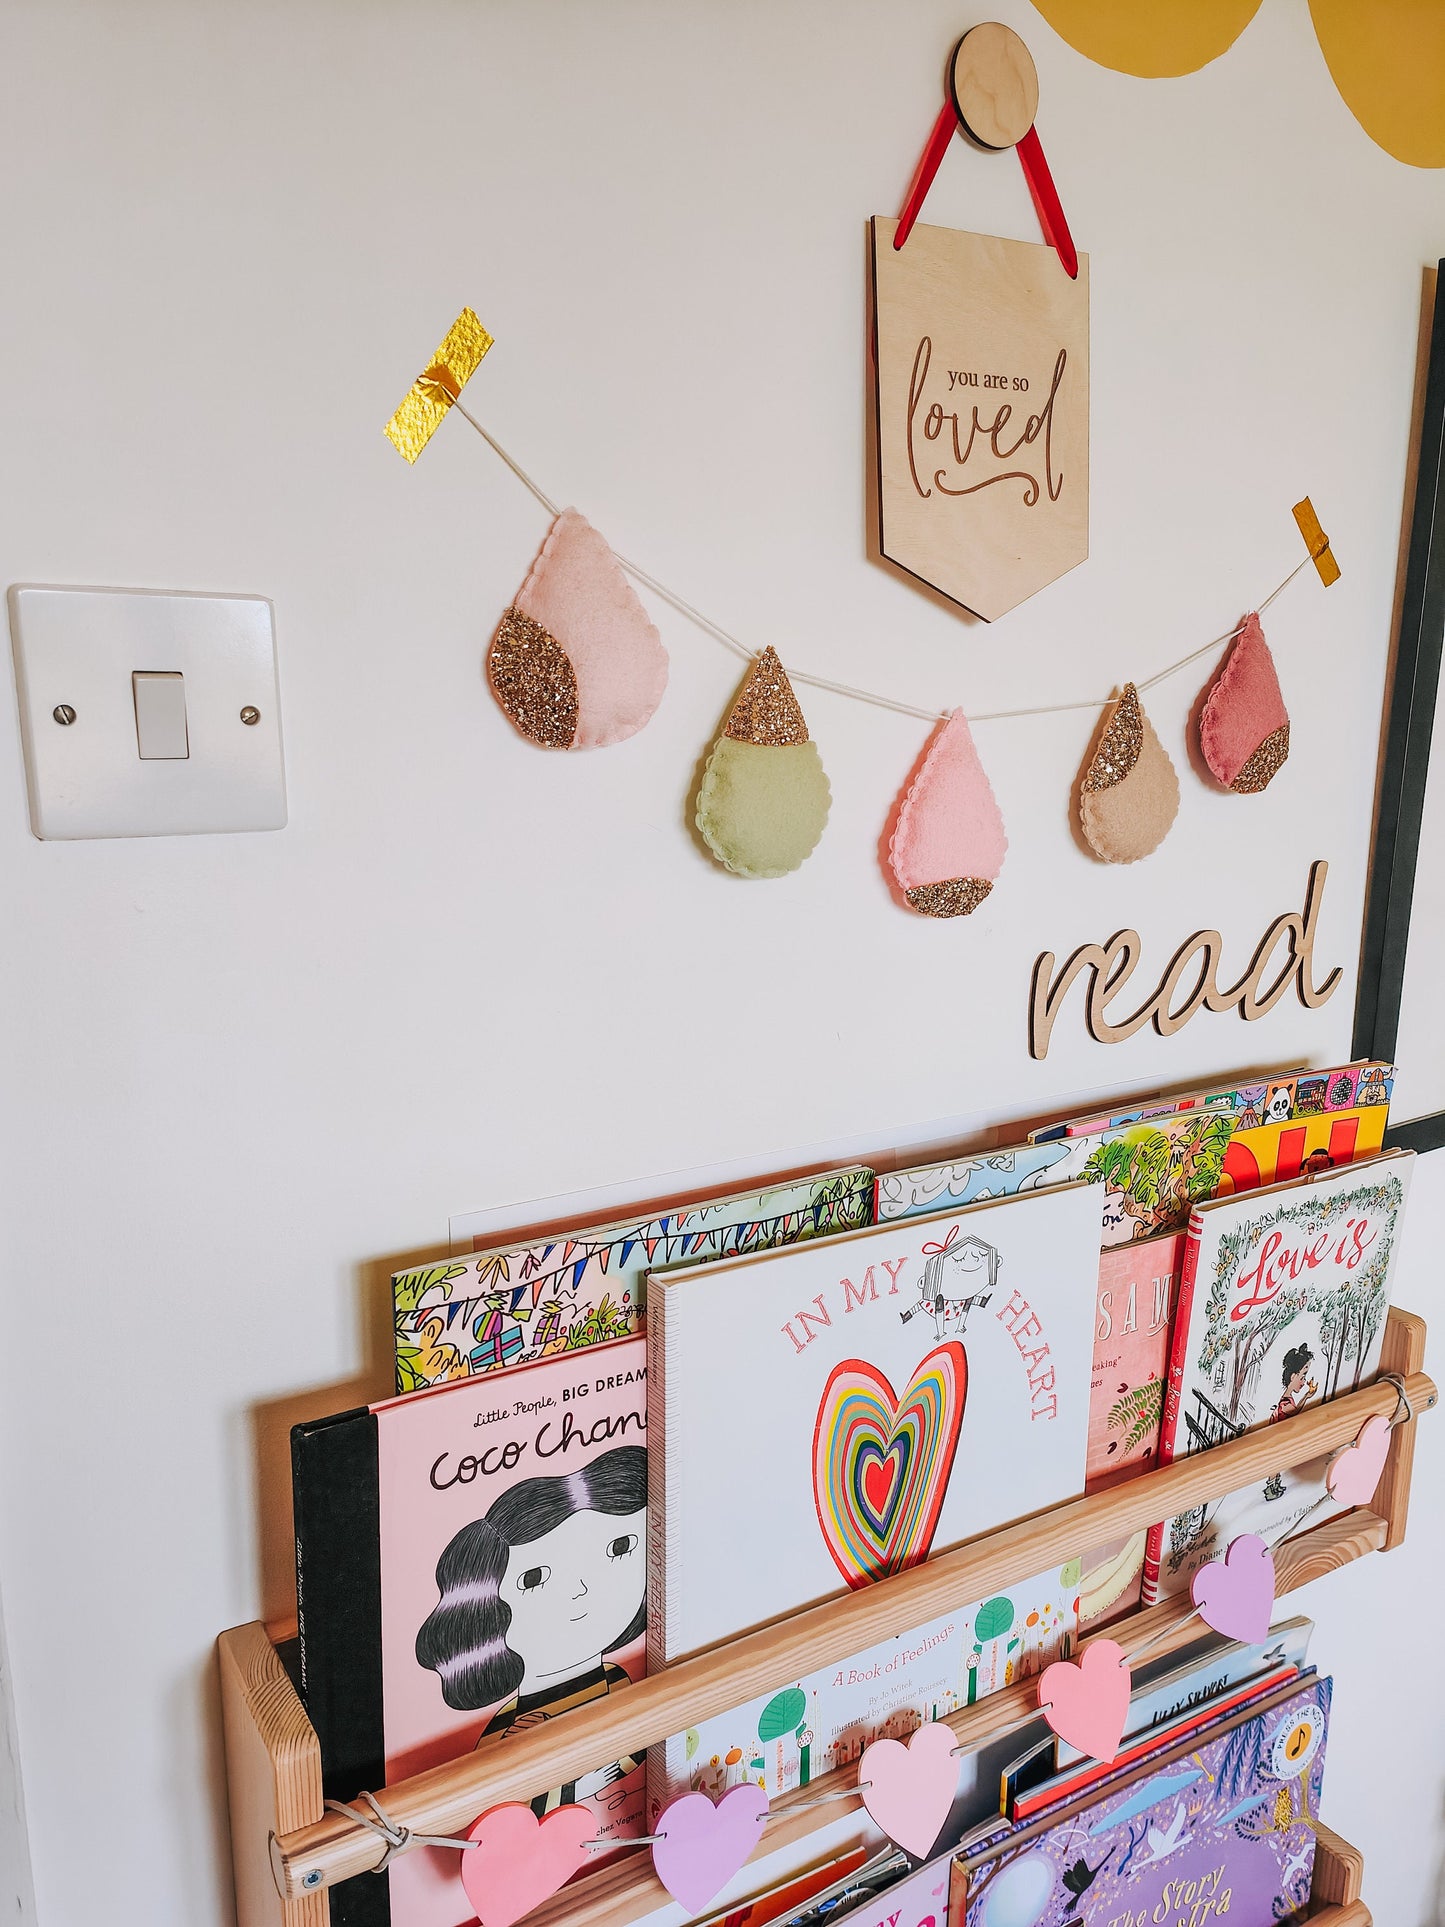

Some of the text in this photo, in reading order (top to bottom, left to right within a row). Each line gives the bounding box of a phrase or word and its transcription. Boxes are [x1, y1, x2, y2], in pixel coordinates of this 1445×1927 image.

[947, 370, 1029, 391] you are so
[907, 336, 1067, 501] loved
[1028, 860, 1343, 1060] read
[780, 1256, 908, 1354] IN MY
[1230, 1218, 1377, 1322] Love is
[995, 1289, 1058, 1421] HEART
[473, 1409, 510, 1428] Little
[512, 1396, 557, 1416] People,
[562, 1383, 589, 1402] BIG
[430, 1411, 648, 1490] Coco Chan
[832, 1623, 955, 1686] A Book of Feelings
[891, 1680, 912, 1695] Witek
[831, 1677, 947, 1736] Illustrated by Christine Roussey
[1152, 1864, 1226, 1924] Story
